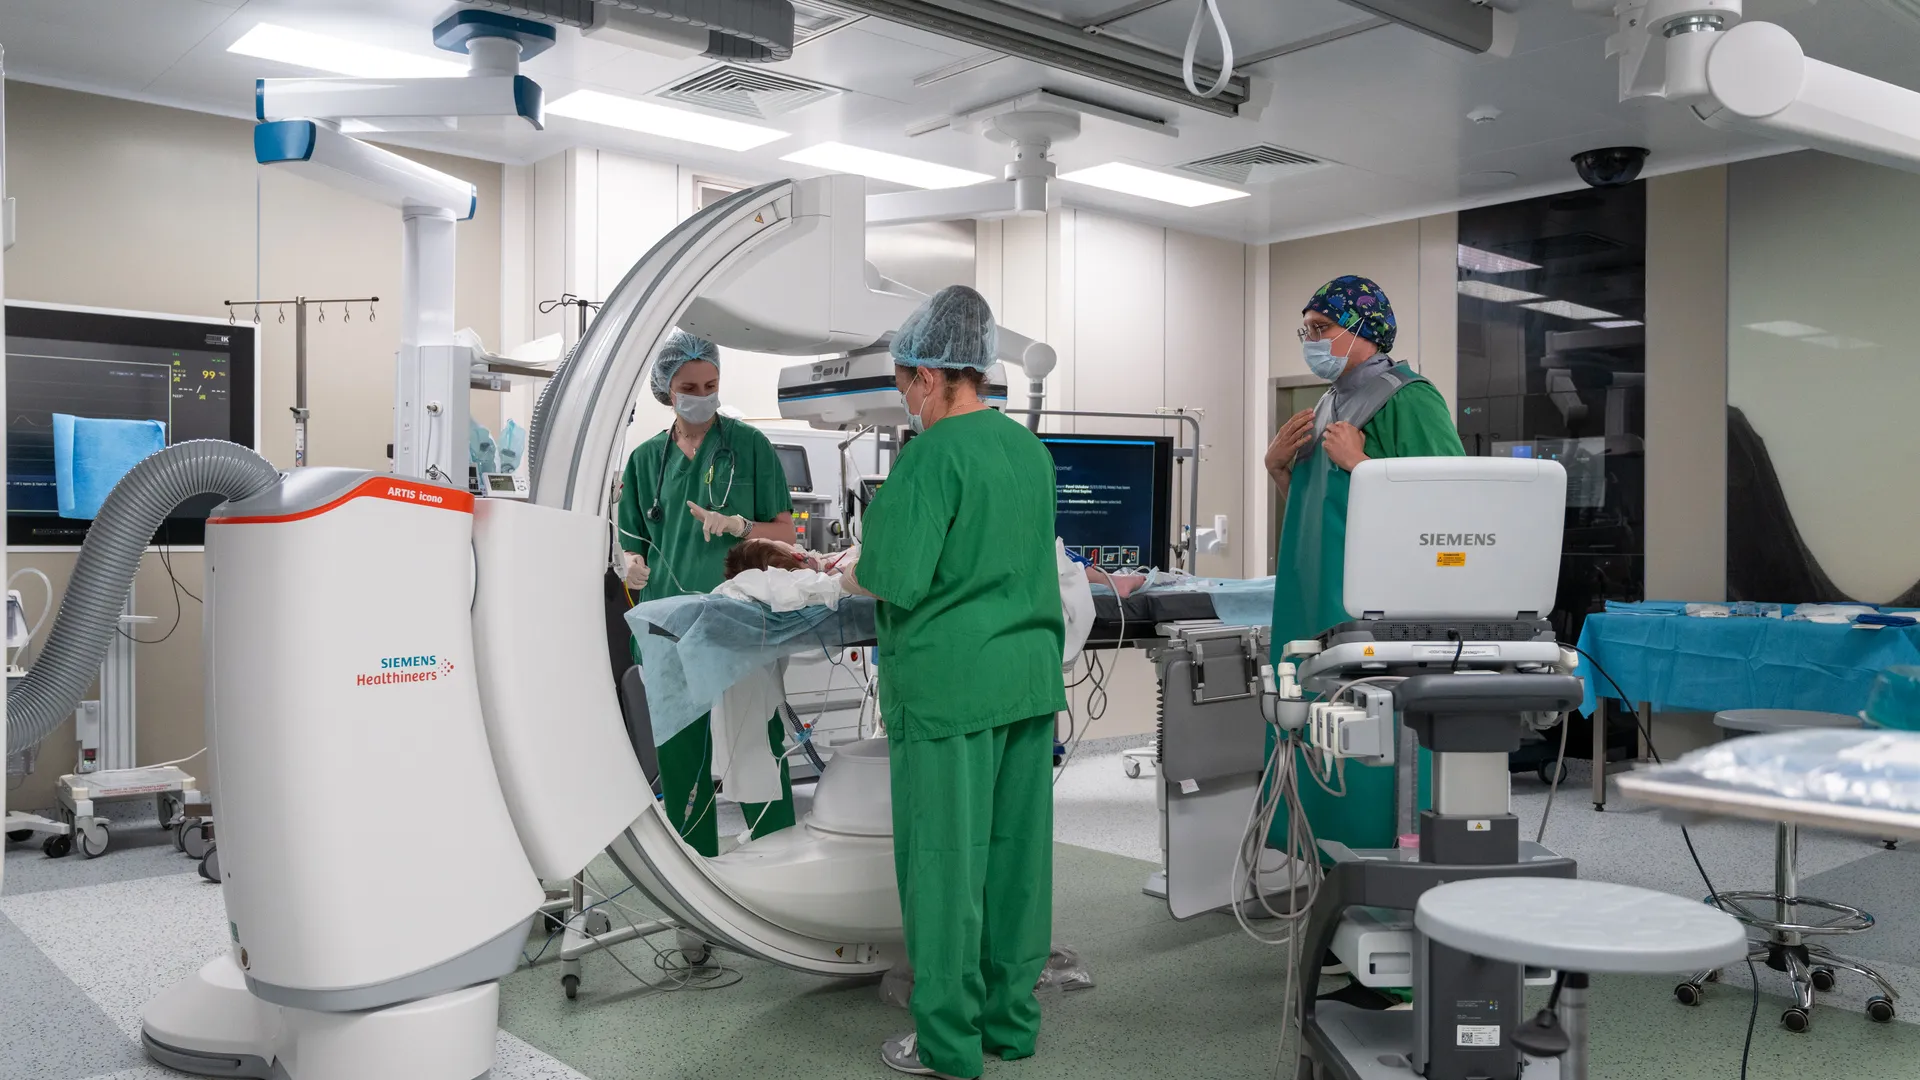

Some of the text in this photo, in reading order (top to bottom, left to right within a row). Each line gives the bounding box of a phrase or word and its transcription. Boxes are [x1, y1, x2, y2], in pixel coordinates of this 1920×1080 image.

[202, 370, 216, 379] 99
[387, 487, 443, 504] ARTIS icono
[1419, 533, 1496, 546] SIEMENS
[381, 655, 436, 668] SIEMENS
[357, 670, 437, 686] Healthineers
